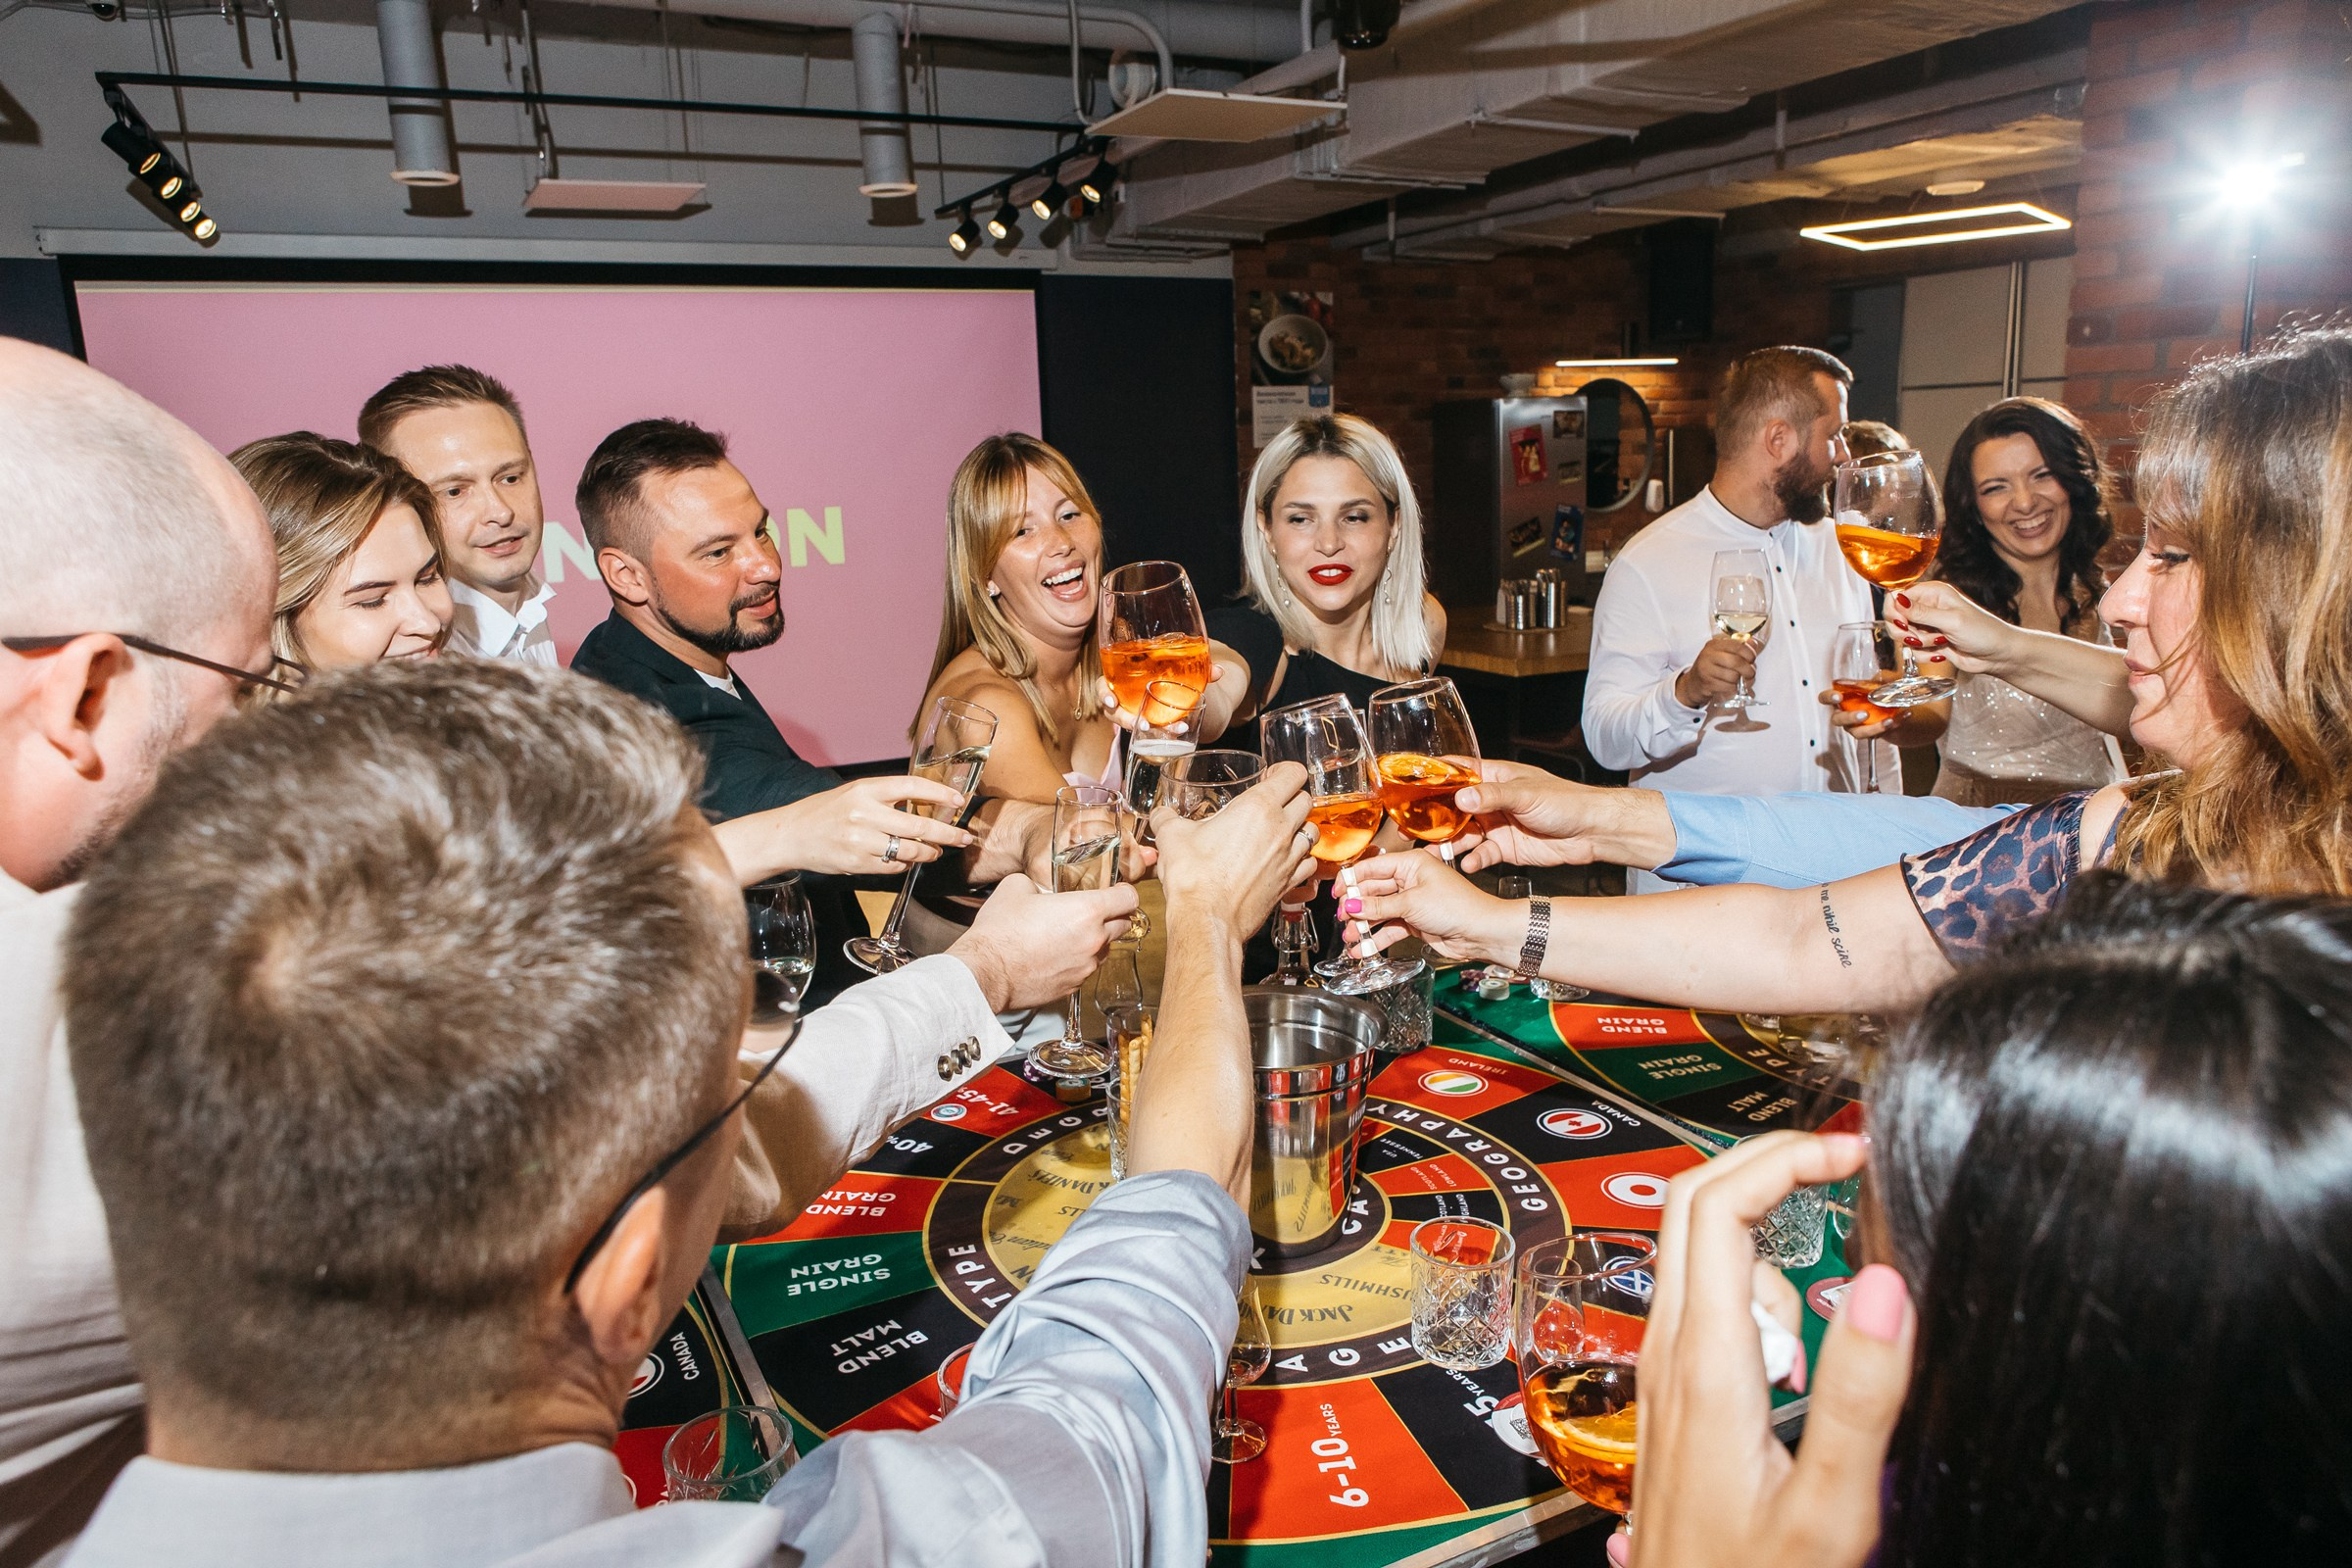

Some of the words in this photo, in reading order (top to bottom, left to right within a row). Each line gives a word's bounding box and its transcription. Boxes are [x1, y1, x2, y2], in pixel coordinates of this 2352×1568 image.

[1823, 905, 1839, 934] nihil
[1596, 1017, 1665, 1026] GRAIN
[1601, 1025, 1667, 1035] BLEND
[1448, 1057, 1509, 1075] IRELAND
[1638, 1054, 1702, 1069] GRAIN
[1651, 1061, 1722, 1080] SINGLE
[1591, 1100, 1641, 1127] CANADA
[1727, 1091, 1768, 1111] MALT
[1747, 1098, 1797, 1121] BLEND
[887, 1135, 933, 1153] 40%
[1367, 1102, 1548, 1211] GEOGRAPHY
[1380, 1138, 1423, 1159] TENNESSEE
[1410, 1166, 1438, 1191] SCOTLAND
[1429, 1163, 1457, 1188] LOWLAND
[806, 1204, 886, 1216] BLEND
[791, 1253, 882, 1279] GRAIN
[948, 1244, 1012, 1308] TYPE
[787, 1268, 891, 1297] SINGLE
[1299, 1304, 1353, 1322] JACK
[831, 1319, 903, 1356] MALT
[670, 1332, 700, 1380] CANADA
[838, 1330, 929, 1373] BLEND
[1275, 1337, 1412, 1372] AGE
[1446, 1369, 1485, 1396] YEARS
[1320, 1403, 1342, 1437] YEARS
[1311, 1438, 1369, 1507] 6-10
